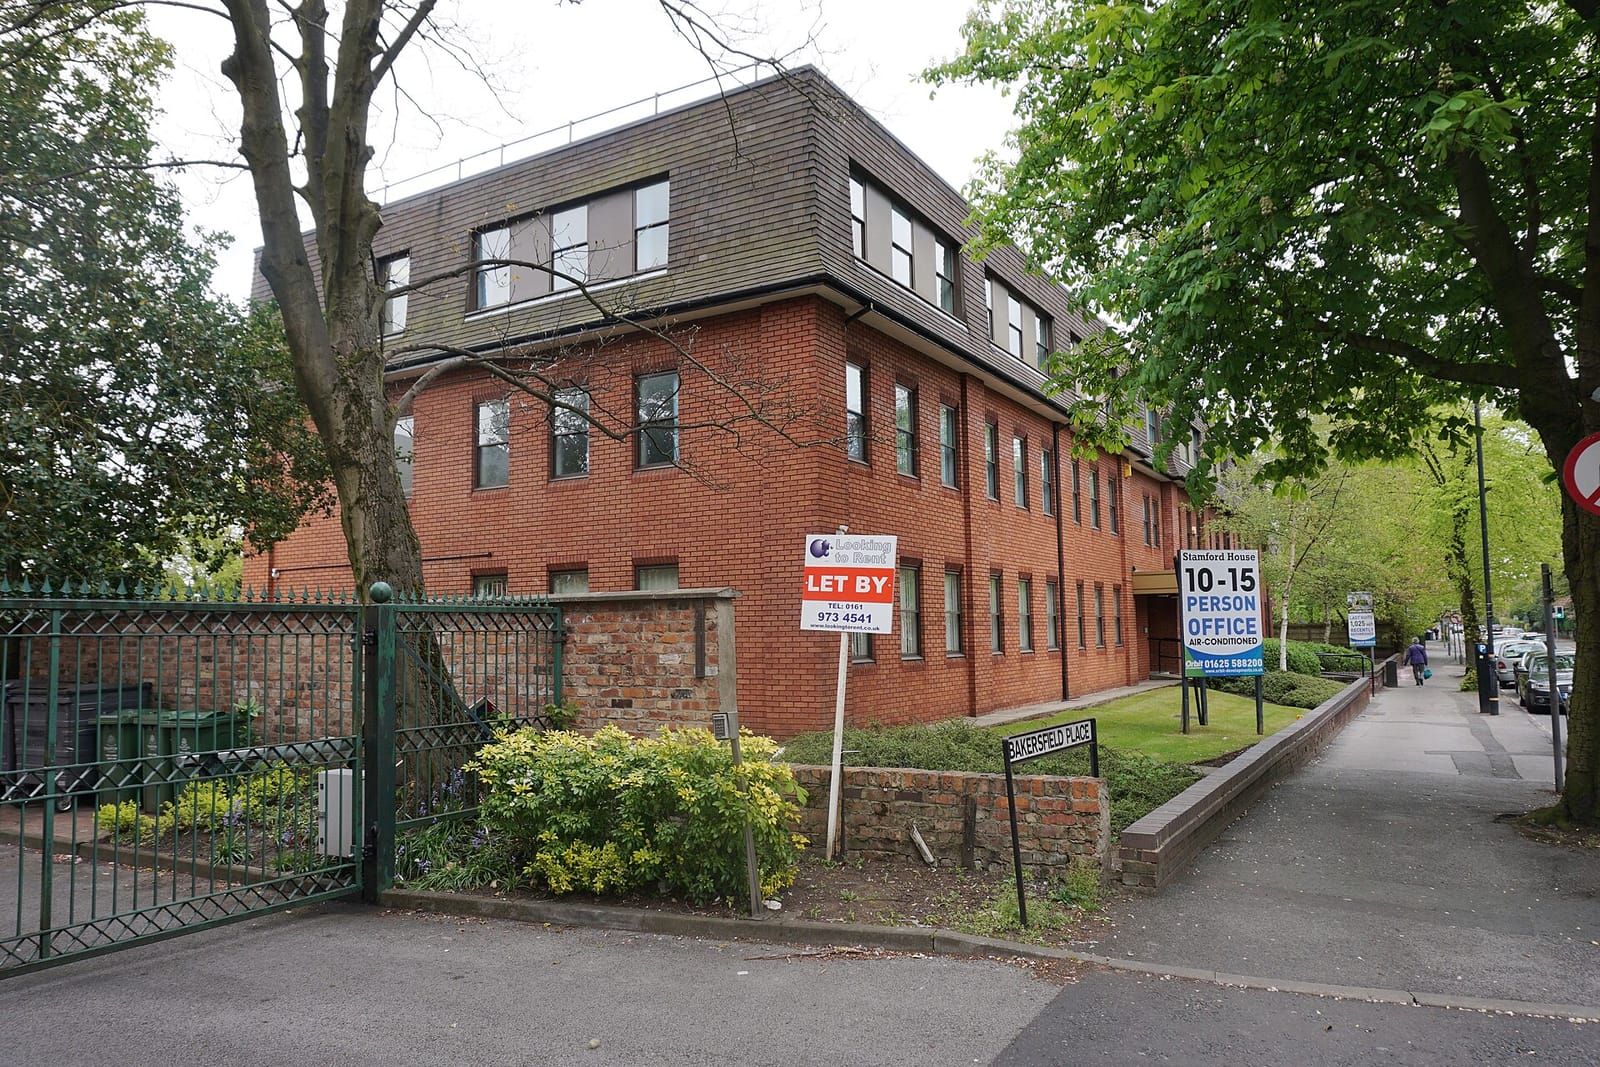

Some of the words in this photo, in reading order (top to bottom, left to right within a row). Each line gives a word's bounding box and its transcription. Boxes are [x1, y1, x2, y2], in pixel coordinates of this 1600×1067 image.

[835, 539, 892, 554] Looking
[835, 552, 849, 563] to
[853, 552, 886, 564] Rent
[1182, 552, 1225, 561] Stamford
[1227, 552, 1256, 561] House
[807, 575, 848, 592] LET
[855, 576, 888, 593] BY
[1187, 595, 1256, 612] PERSON
[817, 611, 839, 622] 973
[842, 613, 872, 623] 4541
[1188, 617, 1257, 636] OFFICE
[1189, 637, 1258, 646] AIR-CONDITIONED
[1185, 659, 1203, 667] Orbit
[1204, 659, 1230, 668] 01625
[1231, 658, 1263, 668] 588200
[1008, 729, 1064, 759] BAKERSFIELD
[1066, 723, 1090, 744] PLACE
